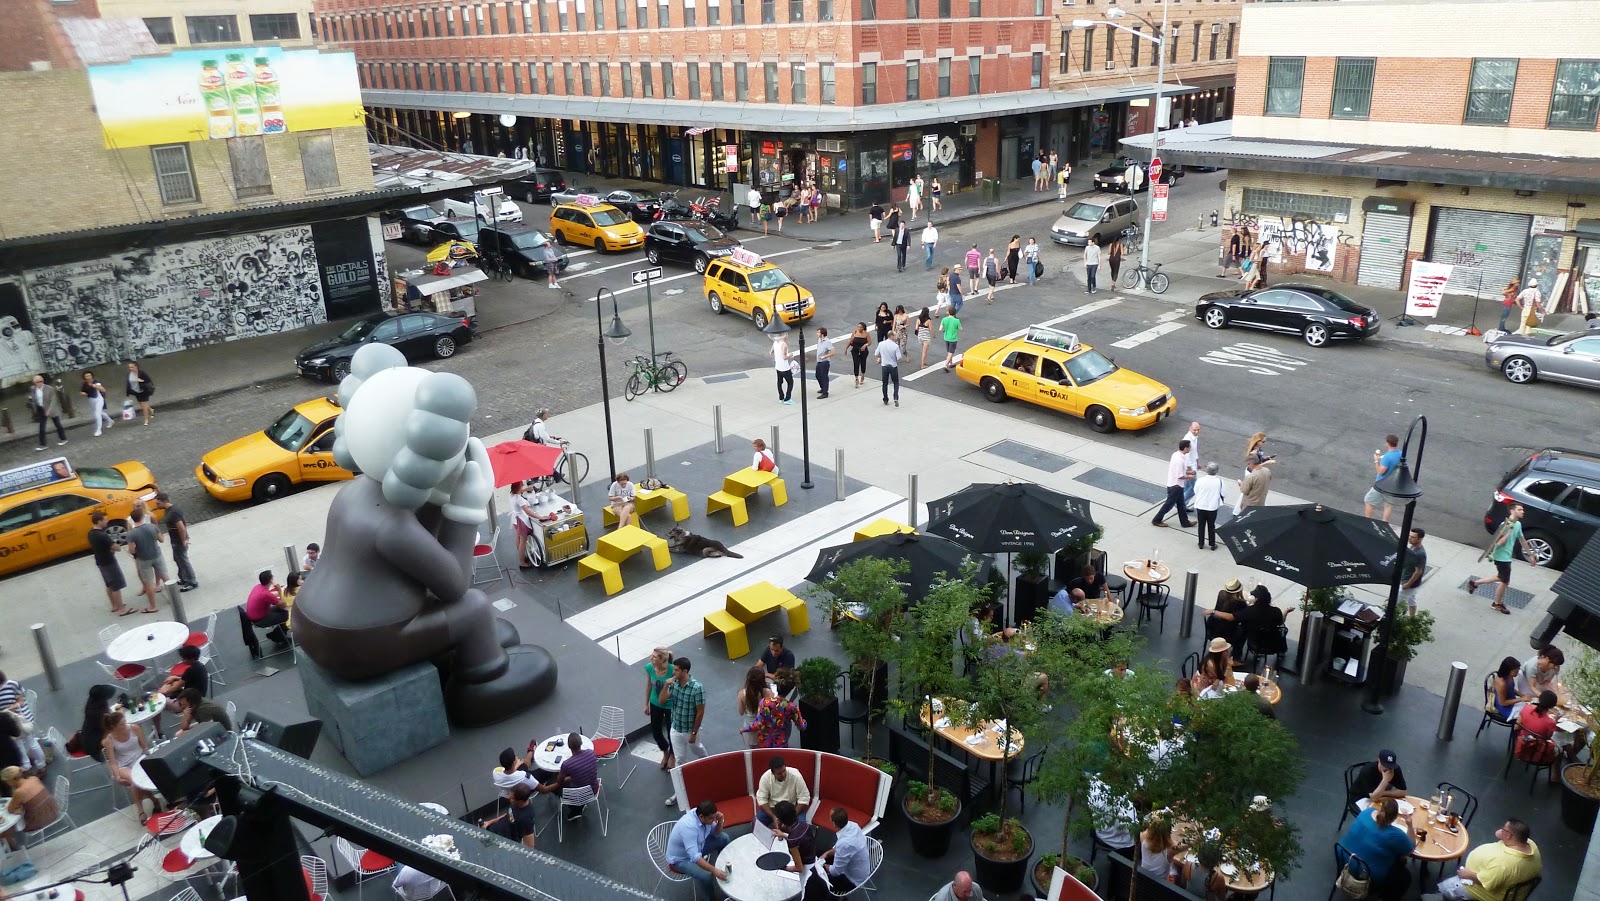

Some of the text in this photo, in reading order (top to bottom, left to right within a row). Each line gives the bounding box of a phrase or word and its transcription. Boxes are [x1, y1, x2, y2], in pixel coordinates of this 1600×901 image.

[1149, 164, 1161, 176] STOP
[336, 260, 369, 273] DETAILS
[327, 271, 356, 286] GUILD
[1049, 388, 1069, 401] TAXI
[316, 459, 340, 469] TAX
